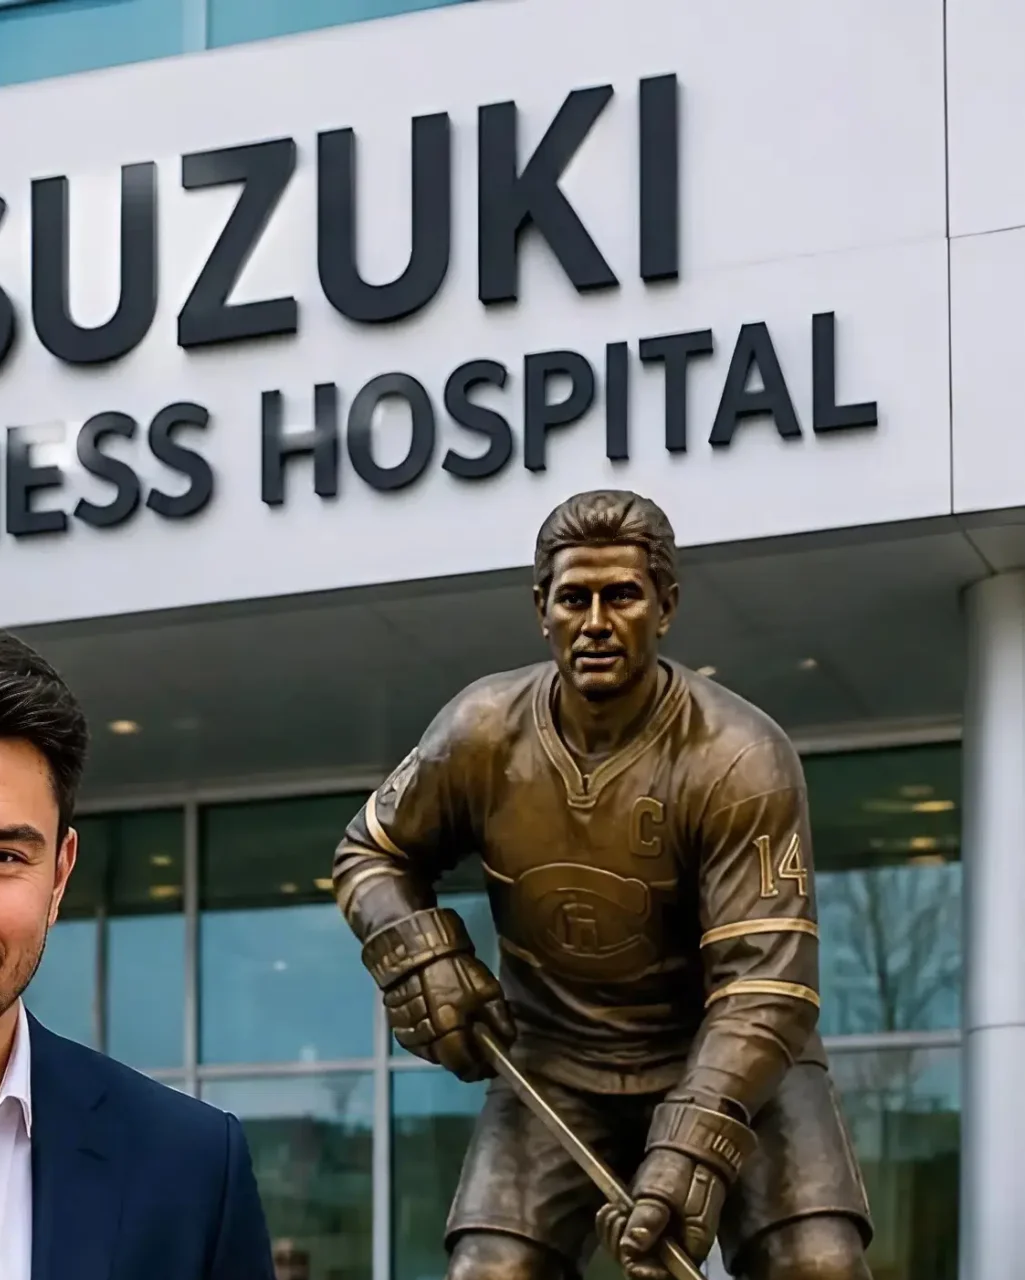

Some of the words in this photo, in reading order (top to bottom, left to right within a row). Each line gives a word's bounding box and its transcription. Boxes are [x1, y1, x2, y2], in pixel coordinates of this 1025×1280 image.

[260, 310, 878, 508] HOSPITAL
[629, 796, 667, 858] C
[753, 833, 809, 899] 14
